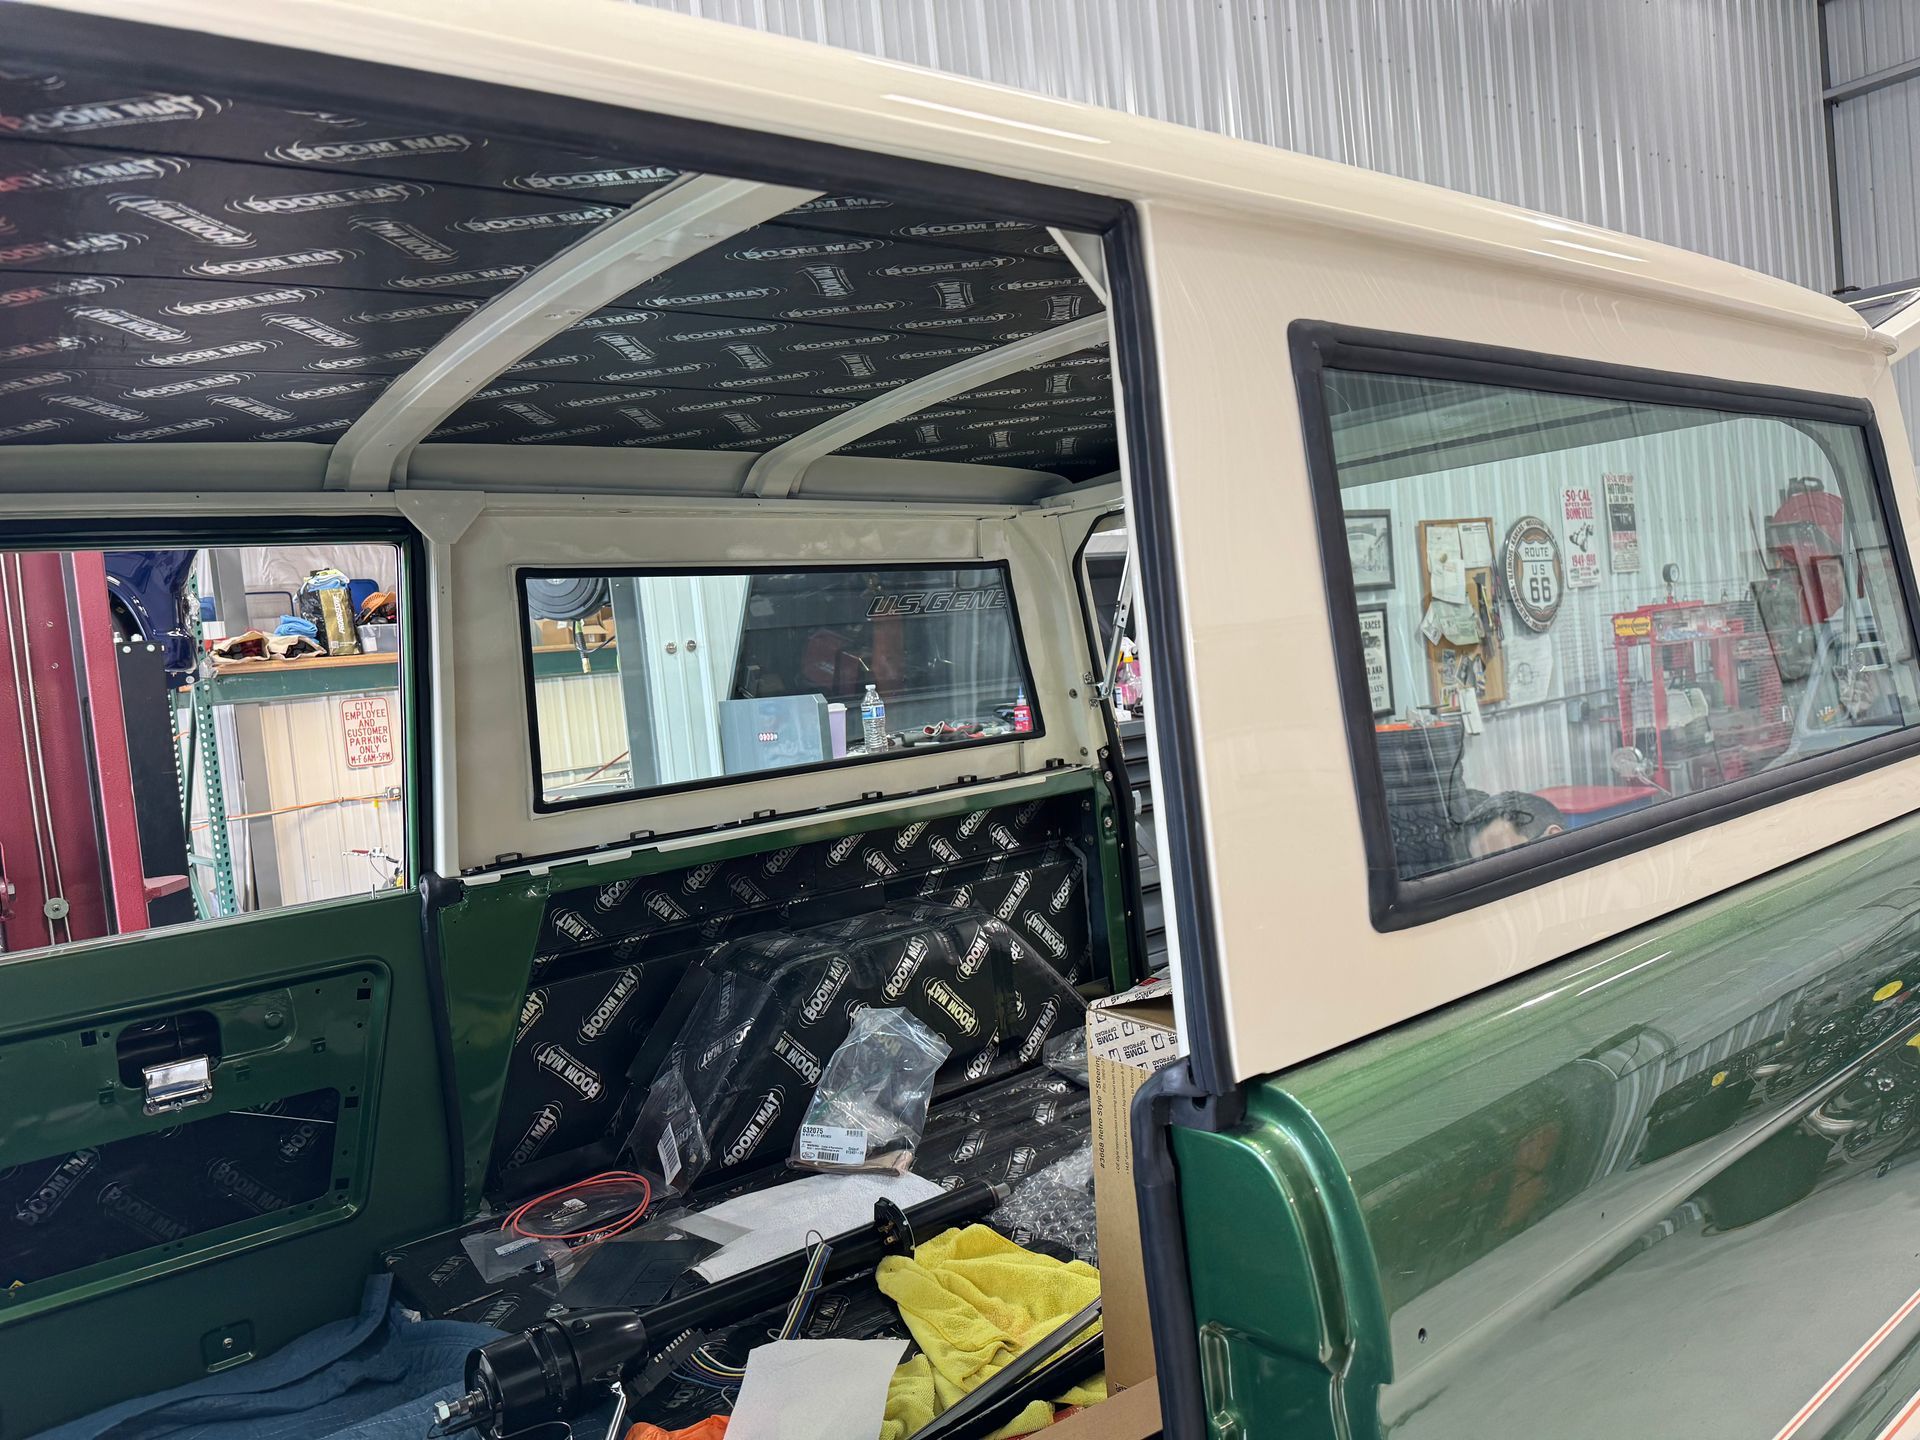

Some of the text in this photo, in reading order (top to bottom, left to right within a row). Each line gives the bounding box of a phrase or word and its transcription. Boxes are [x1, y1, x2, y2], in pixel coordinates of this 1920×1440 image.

[119, 95, 203, 118] MAT
[287, 134, 472, 161] BOOM MAT
[524, 172, 622, 189] BOOM
[243, 185, 410, 212] BOOM MAT
[464, 208, 615, 231] BOOM MAT
[909, 223, 986, 236] BOOM
[743, 240, 875, 261] BOOM MAT
[203, 250, 344, 274] BOOM MAT
[885, 258, 1007, 276] BOOM MAT
[397, 265, 526, 288] BOOM MAT
[1008, 279, 1071, 290] BOOM
[175, 289, 306, 315] BOOM MAT
[652, 288, 769, 307] BOOM MAT
[358, 301, 480, 322] BOOM MAT
[604, 312, 648, 323] MAT
[788, 301, 897, 318] BOOM MAT
[904, 313, 1007, 330] BOOM MAT
[673, 324, 778, 342] BOOM MAT
[793, 334, 892, 351] BOOM MAT
[150, 341, 267, 366] BOOM MAT
[548, 356, 581, 366] MAT
[606, 363, 703, 382] BOOM MAT
[721, 371, 812, 387] BOOM MAT
[131, 374, 241, 398] BOOM MAT
[290, 384, 349, 399] BOOM
[504, 384, 541, 394] MAT
[567, 390, 658, 407] BOOM MAT
[678, 395, 764, 412] BOOM MAT
[117, 419, 214, 440] BOOM MAT
[1565, 489, 1591, 502] SO-CAL
[1566, 507, 1594, 520] BONNEVILLE
[1524, 546, 1550, 558] ROUTE
[1529, 576, 1552, 603] 66
[1364, 619, 1381, 630] RACES
[345, 709, 386, 720] EMPLOYEE
[355, 701, 373, 710] CITY
[347, 726, 388, 737] CUSTOMER
[359, 718, 376, 728] AND
[350, 735, 387, 746] PARKING
[360, 744, 380, 755] ONLY
[991, 826, 1012, 849] MAT
[931, 838, 953, 861] MAT
[866, 852, 887, 875] MAT
[1014, 871, 1032, 897] MAT
[646, 894, 672, 918] MAT
[555, 913, 585, 937] MAT
[1026, 913, 1066, 957] BOOM MAT
[885, 936, 927, 997] BOOM MAT
[960, 938, 988, 976] BOOM
[520, 992, 544, 1023] MAT
[582, 968, 640, 1039] BOOM MAT
[803, 980, 834, 1021] BOOM
[927, 982, 976, 1033] BOOM MAT
[1038, 1001, 1058, 1034] MAT
[1096, 1032, 1120, 1046] TOMS
[1124, 1045, 1149, 1059] TOMS
[538, 1047, 601, 1099] BOOM MAT
[787, 1050, 821, 1083] BOOM
[533, 1107, 558, 1140] MAT
[725, 1092, 782, 1168] BOOM MAT
[802, 1126, 824, 1135] 632075
[218, 1162, 260, 1201] BOOM
[17, 1173, 69, 1226] BOOM
[104, 1185, 155, 1228] BOOM
